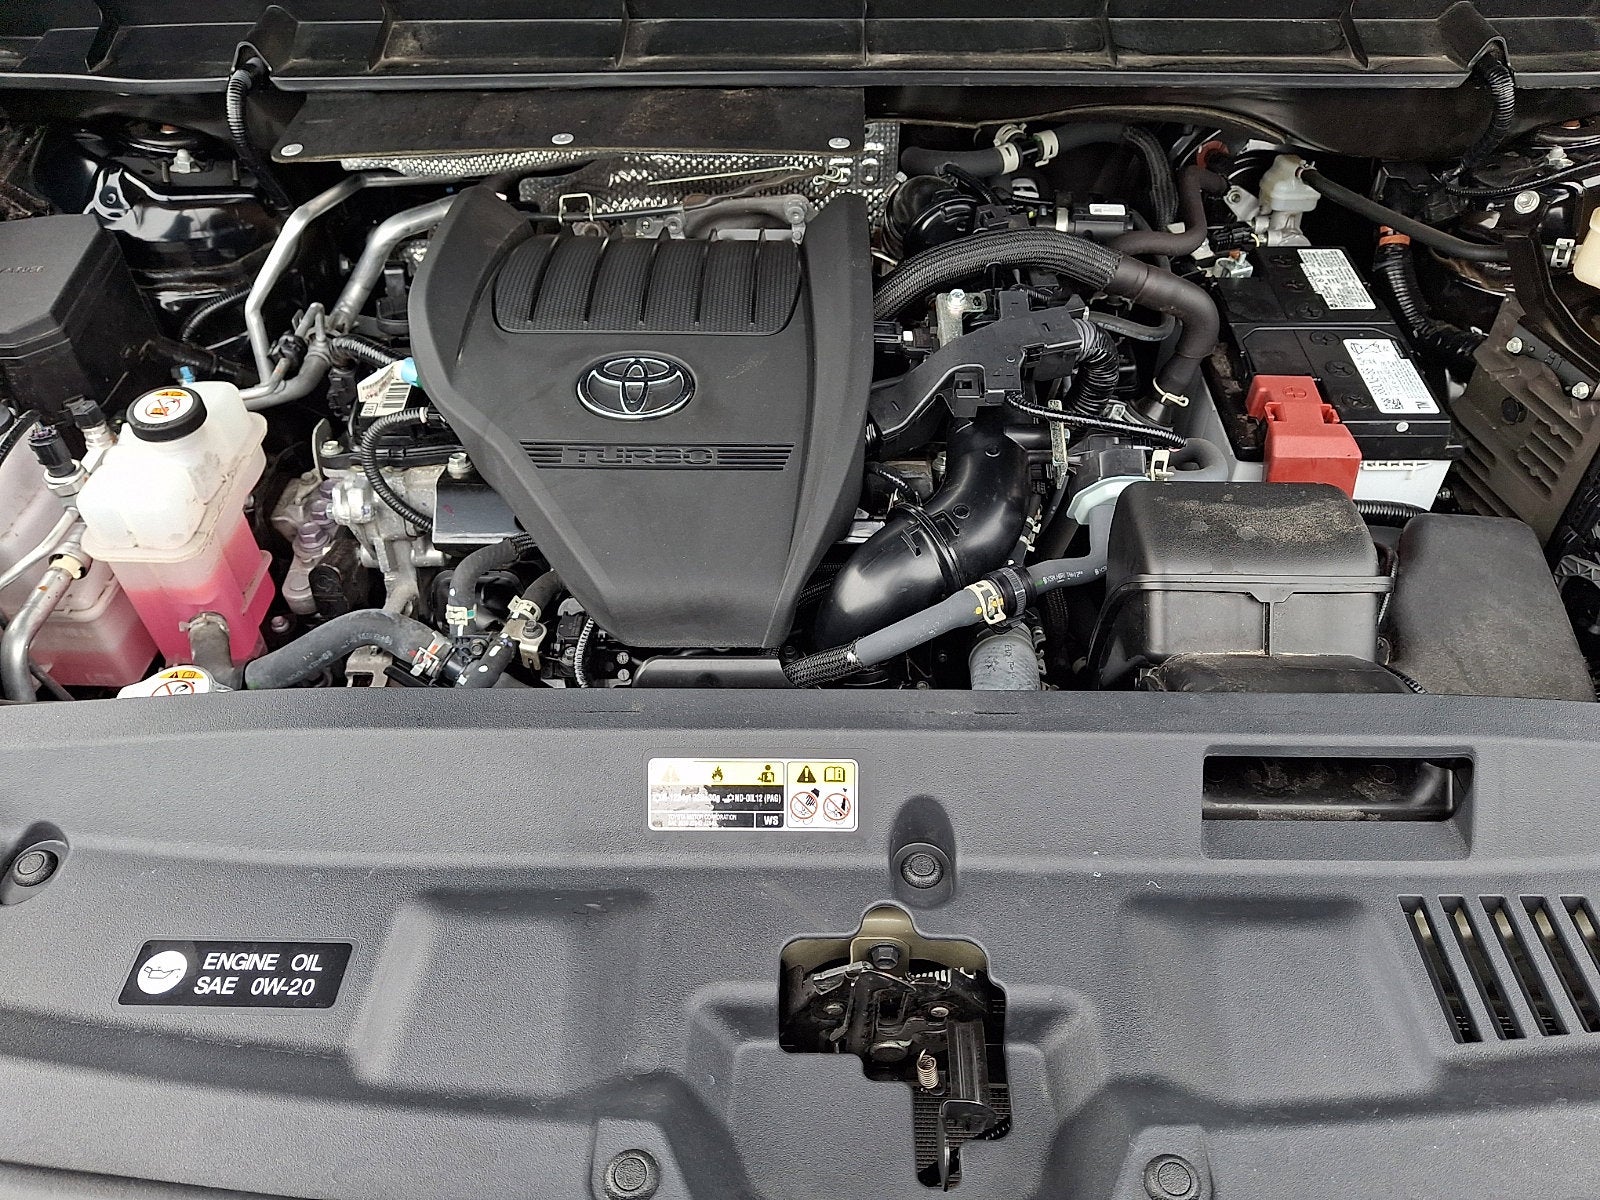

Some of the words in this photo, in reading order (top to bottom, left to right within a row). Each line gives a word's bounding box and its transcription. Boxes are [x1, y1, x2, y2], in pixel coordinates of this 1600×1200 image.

[567, 447, 714, 464] TURBO
[765, 793, 781, 803] (PAG)
[764, 816, 779, 825] WS
[203, 953, 280, 970] ENGINE
[291, 954, 323, 972] OIL
[193, 977, 239, 994] SAE
[251, 978, 315, 995] 0W-20
